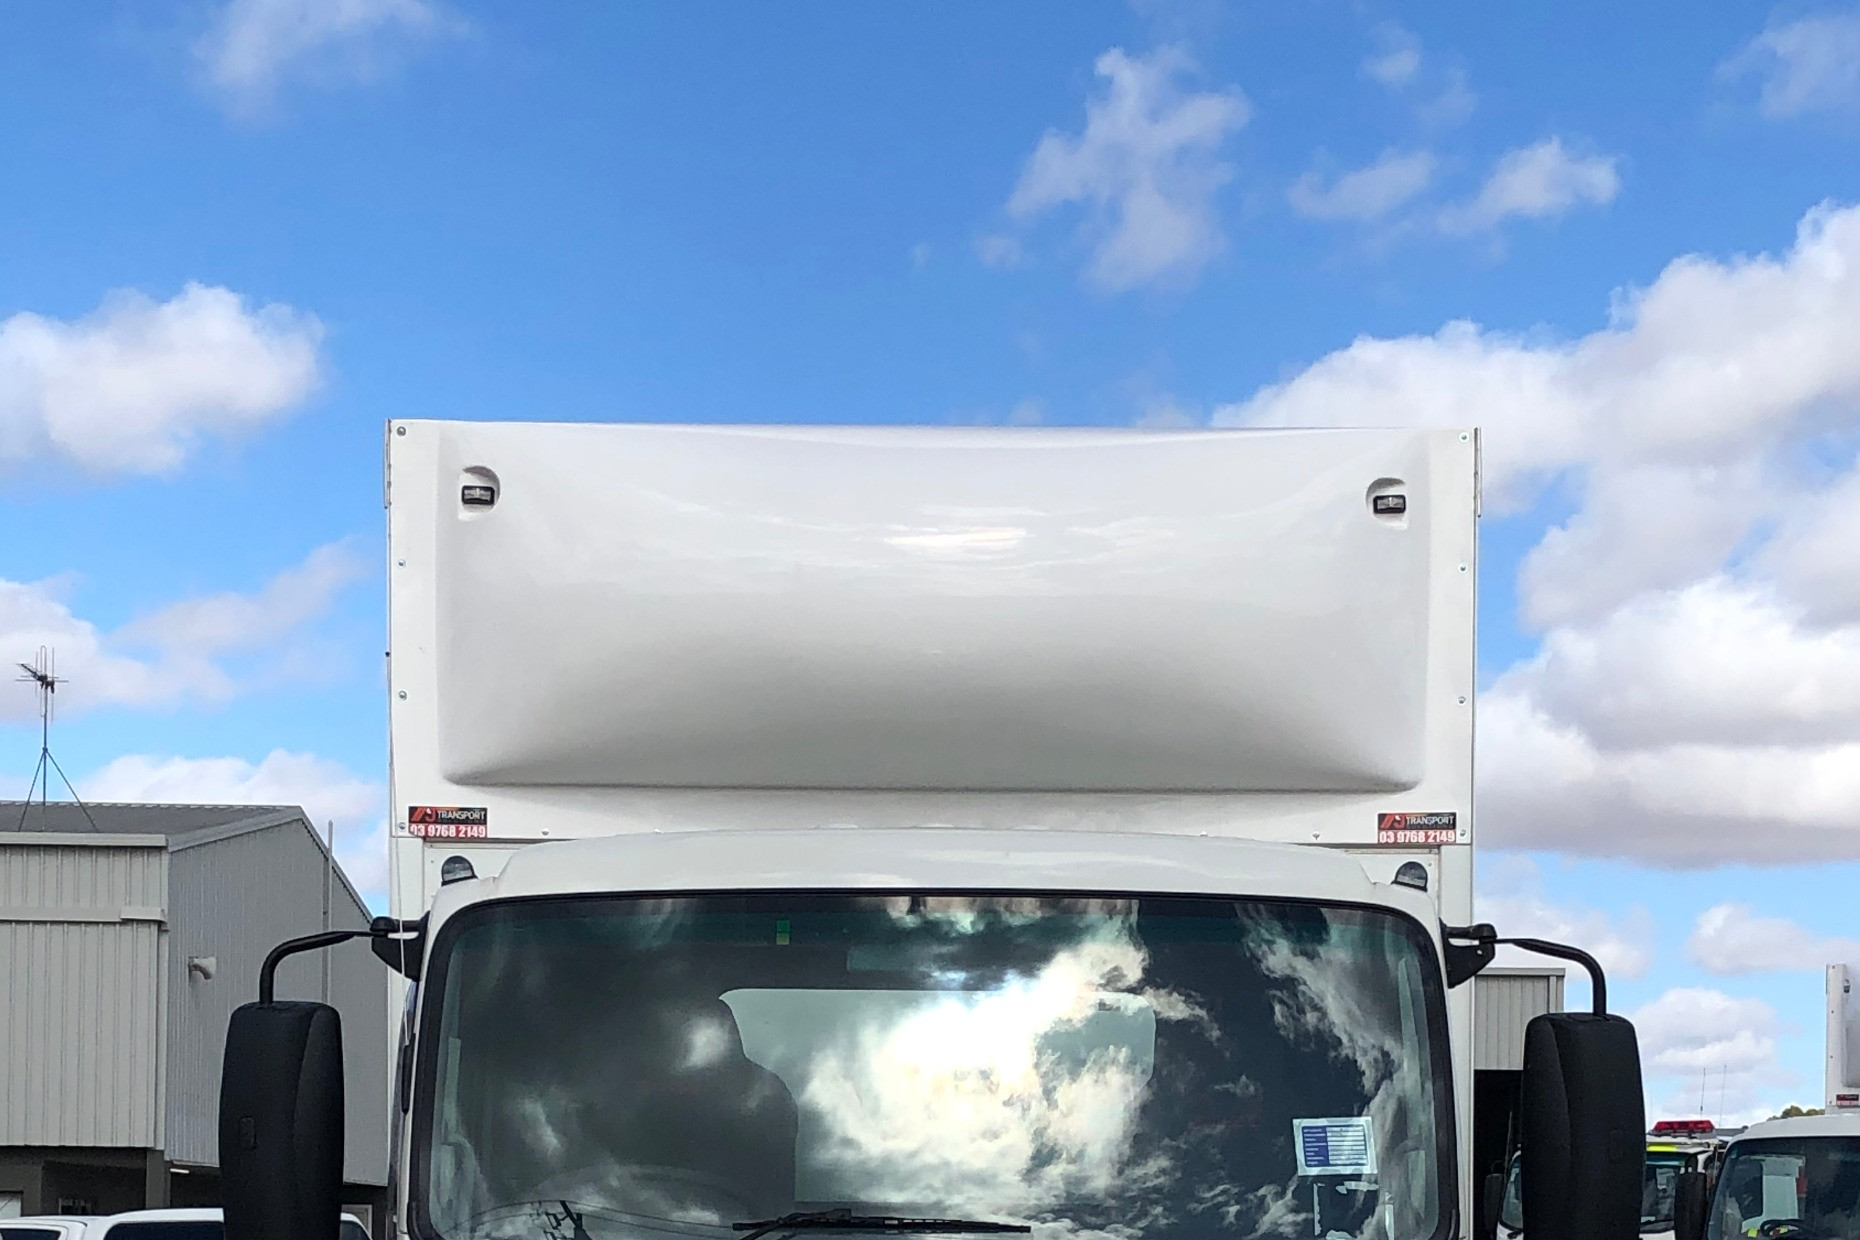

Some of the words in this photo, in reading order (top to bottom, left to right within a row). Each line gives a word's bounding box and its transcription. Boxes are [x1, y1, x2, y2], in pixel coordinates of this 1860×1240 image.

[437, 810, 485, 820] TRANSPORT
[1406, 815, 1454, 825] TRANSPORT
[410, 824, 425, 837] 03
[428, 825, 456, 837] 9768
[459, 826, 486, 838] 2149
[1380, 831, 1394, 843] 03
[1397, 831, 1425, 843] 9768
[1427, 830, 1455, 843] 2149
